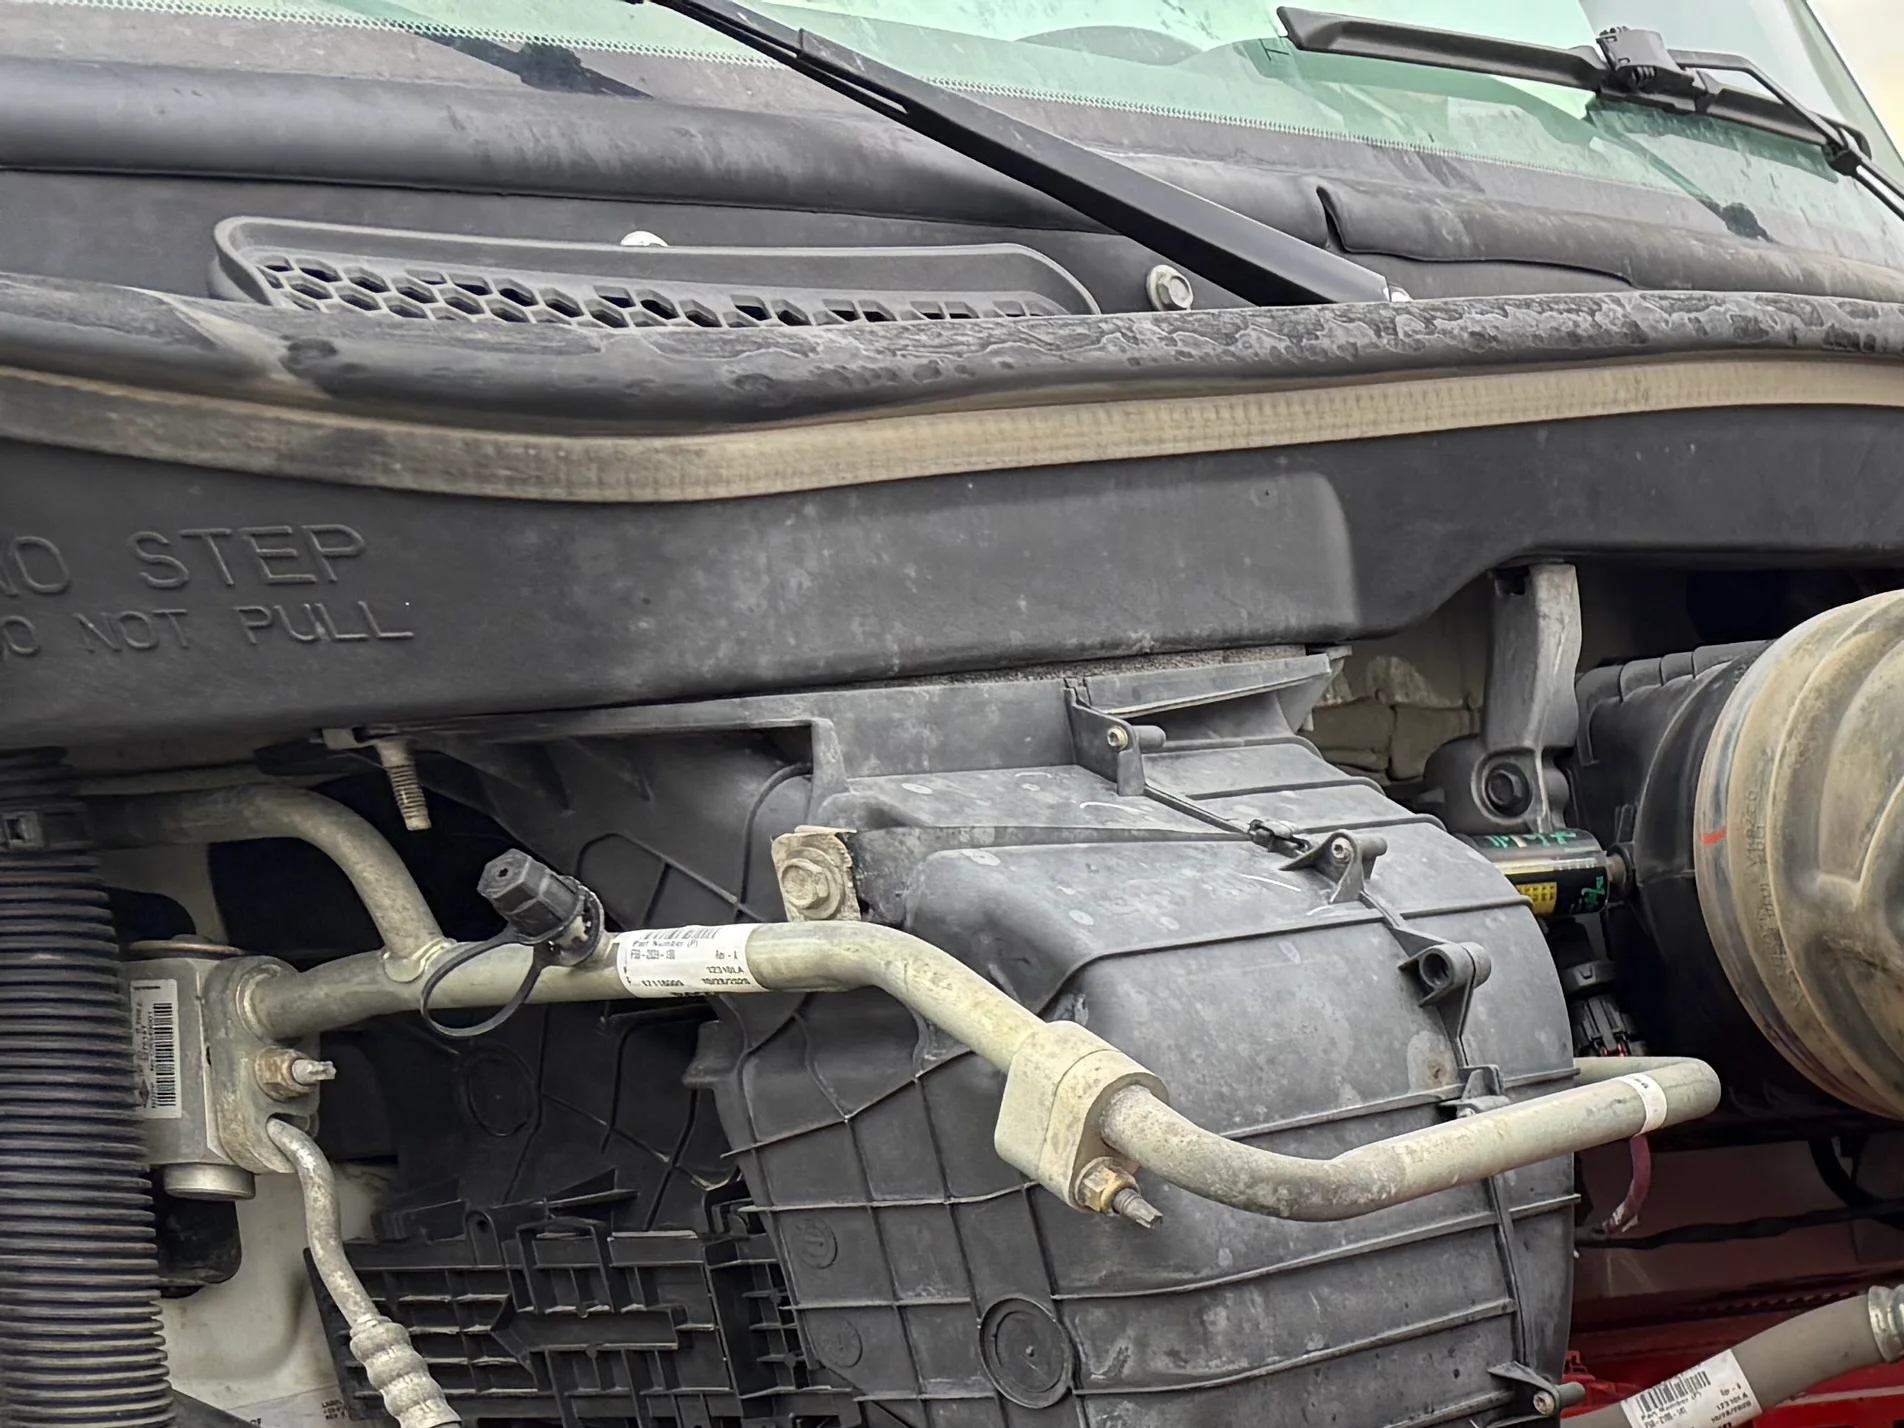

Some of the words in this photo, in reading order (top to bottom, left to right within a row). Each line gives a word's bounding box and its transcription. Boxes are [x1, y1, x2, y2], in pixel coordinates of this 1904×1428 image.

[0, 536, 69, 597] O
[129, 523, 366, 591] STEP
[73, 608, 188, 653] NOT
[234, 600, 415, 646] PULL
